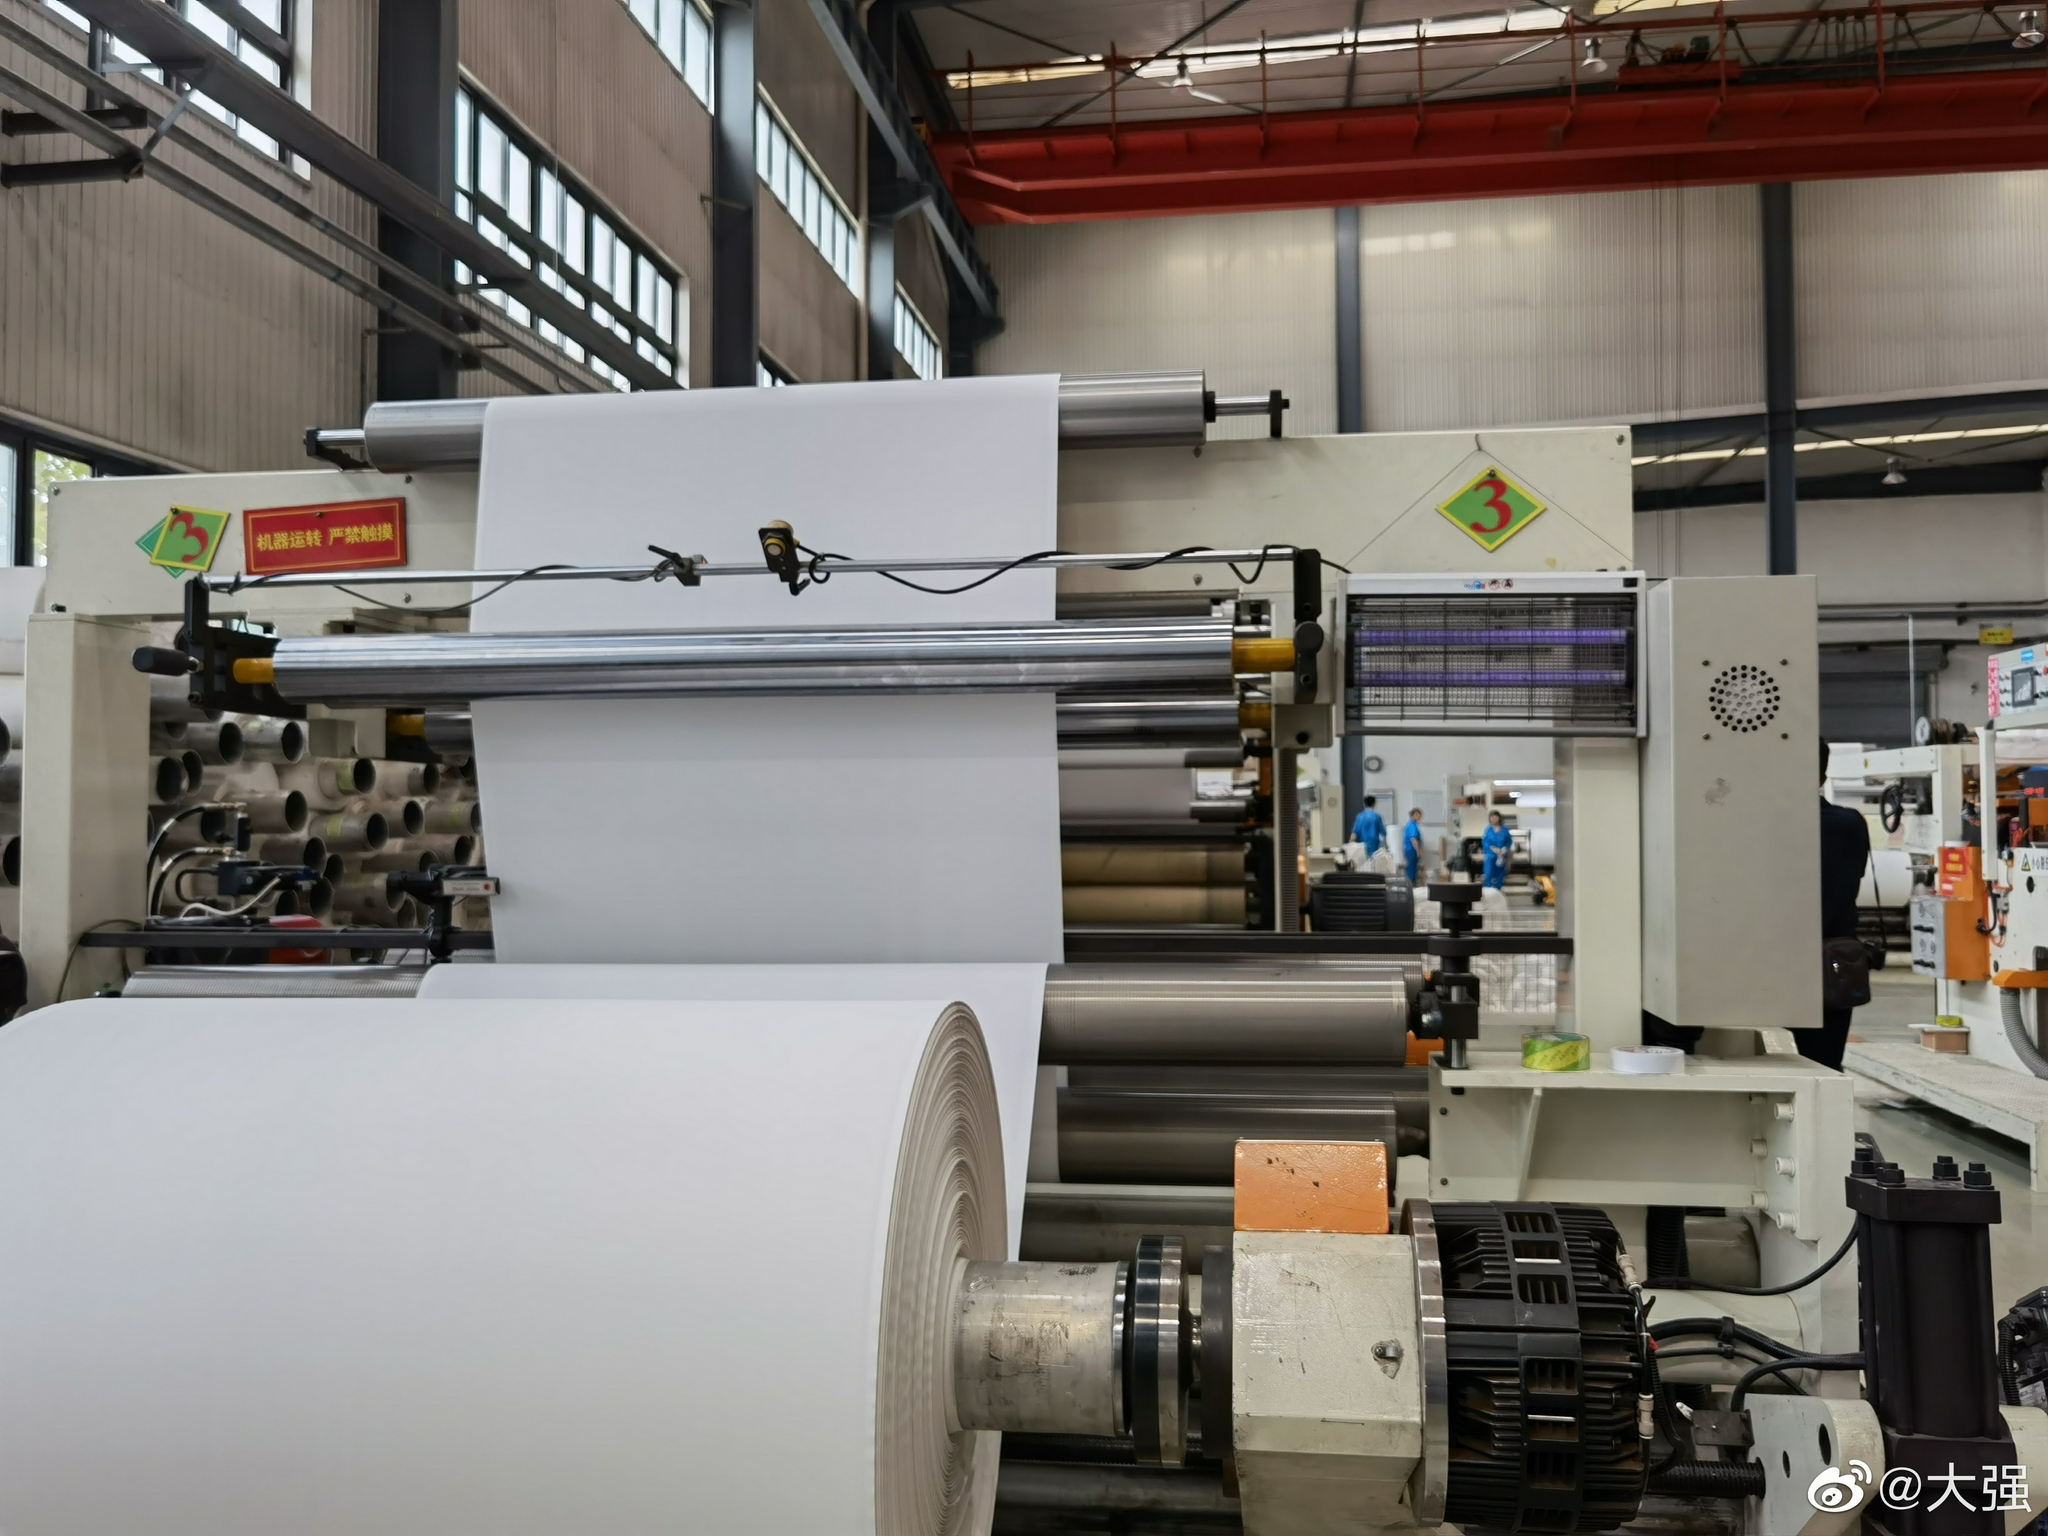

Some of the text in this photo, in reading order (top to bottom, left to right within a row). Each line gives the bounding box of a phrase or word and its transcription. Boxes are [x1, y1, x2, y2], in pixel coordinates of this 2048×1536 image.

[1469, 479, 1513, 534] 3
[169, 512, 210, 563] 3
[256, 522, 394, 552] 机器运转 严禁触摸
